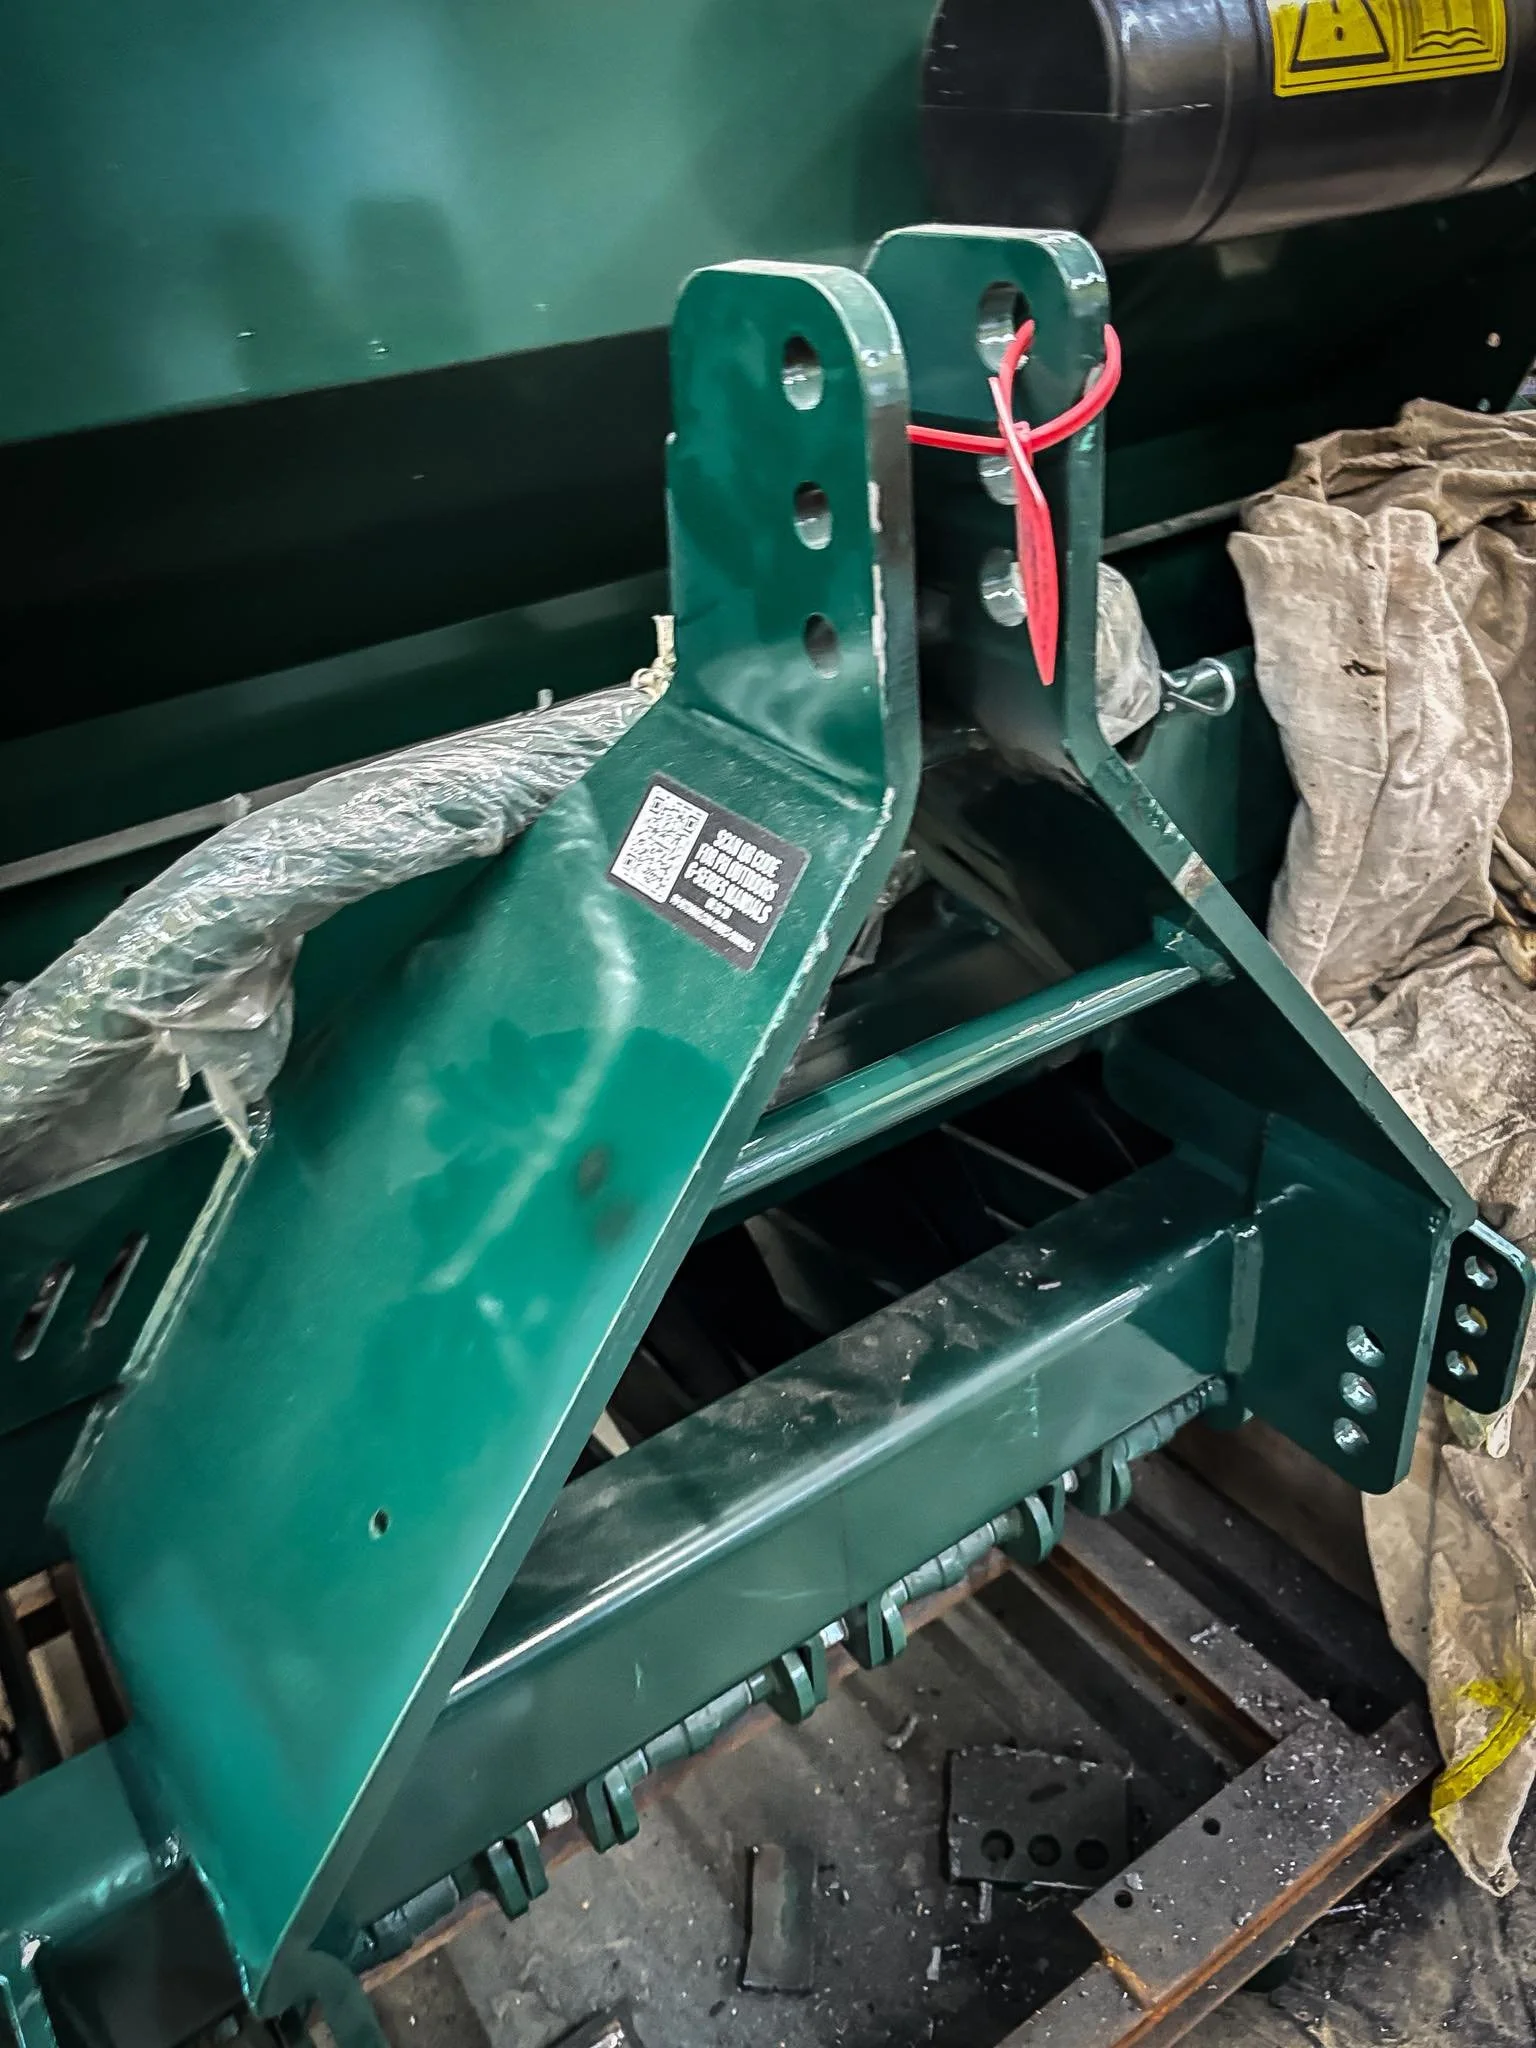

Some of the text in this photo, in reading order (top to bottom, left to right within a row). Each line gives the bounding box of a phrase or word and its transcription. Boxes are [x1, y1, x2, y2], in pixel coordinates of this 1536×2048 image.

[694, 843, 720, 867] FOR
[713, 829, 744, 857] SCAN
[750, 849, 783, 878] CODE
